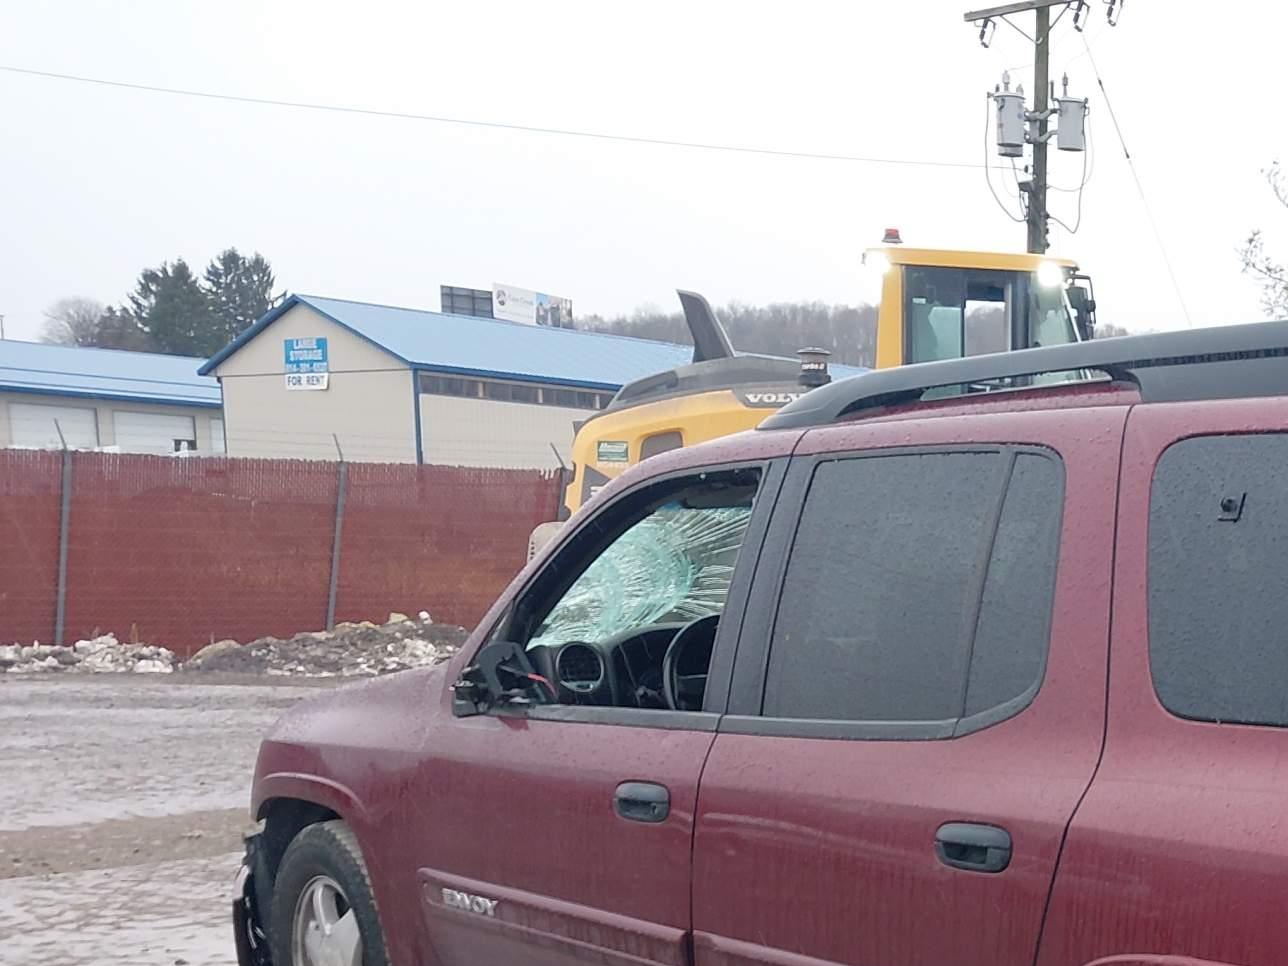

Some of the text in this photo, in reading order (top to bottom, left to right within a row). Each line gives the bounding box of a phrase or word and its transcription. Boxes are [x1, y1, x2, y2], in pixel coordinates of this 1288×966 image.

[287, 375, 325, 386] FOR RENT
[745, 392, 807, 403] VOLV
[442, 887, 500, 917] ENVOY
